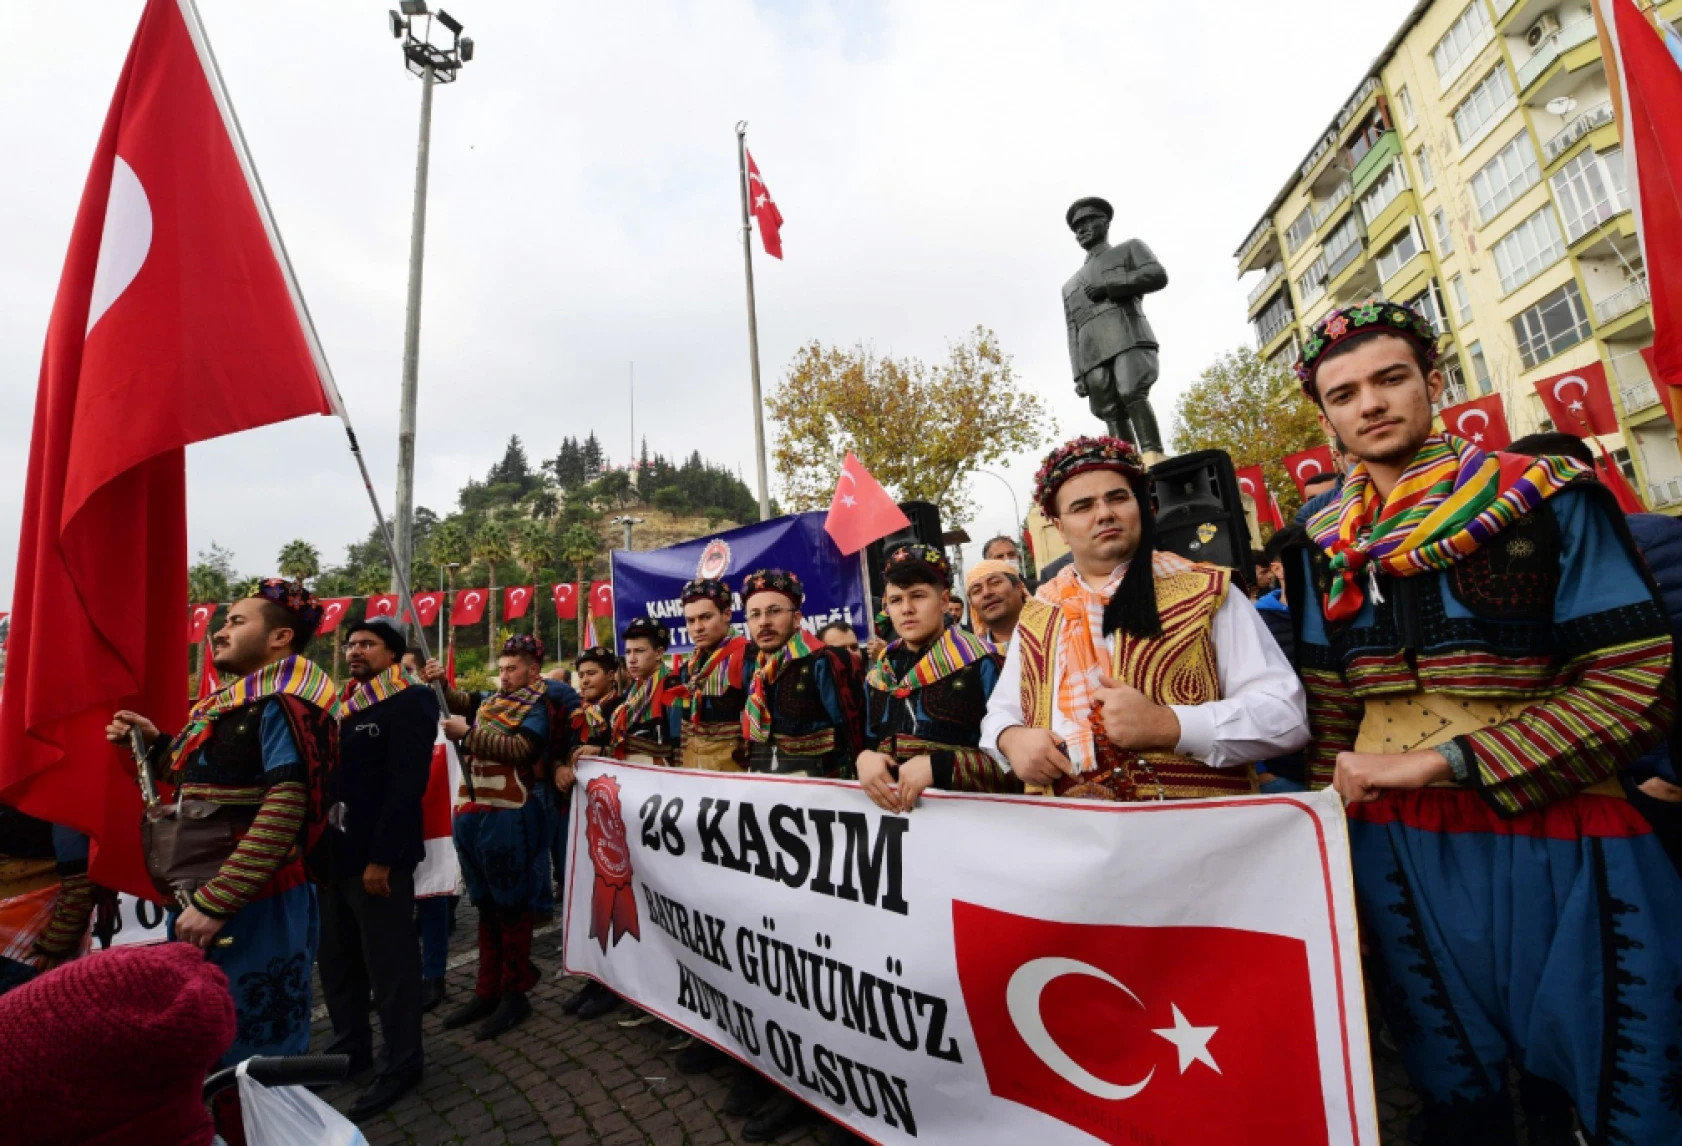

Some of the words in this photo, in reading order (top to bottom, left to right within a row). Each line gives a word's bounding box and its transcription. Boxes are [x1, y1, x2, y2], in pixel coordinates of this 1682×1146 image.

[639, 794, 686, 857] 28
[697, 797, 909, 916] KASIM
[640, 881, 733, 972] BAYRAK
[736, 916, 963, 1064] GÜNÜMÜZ
[676, 958, 761, 1056] KUTLU
[764, 1019, 918, 1138] OLSUN
